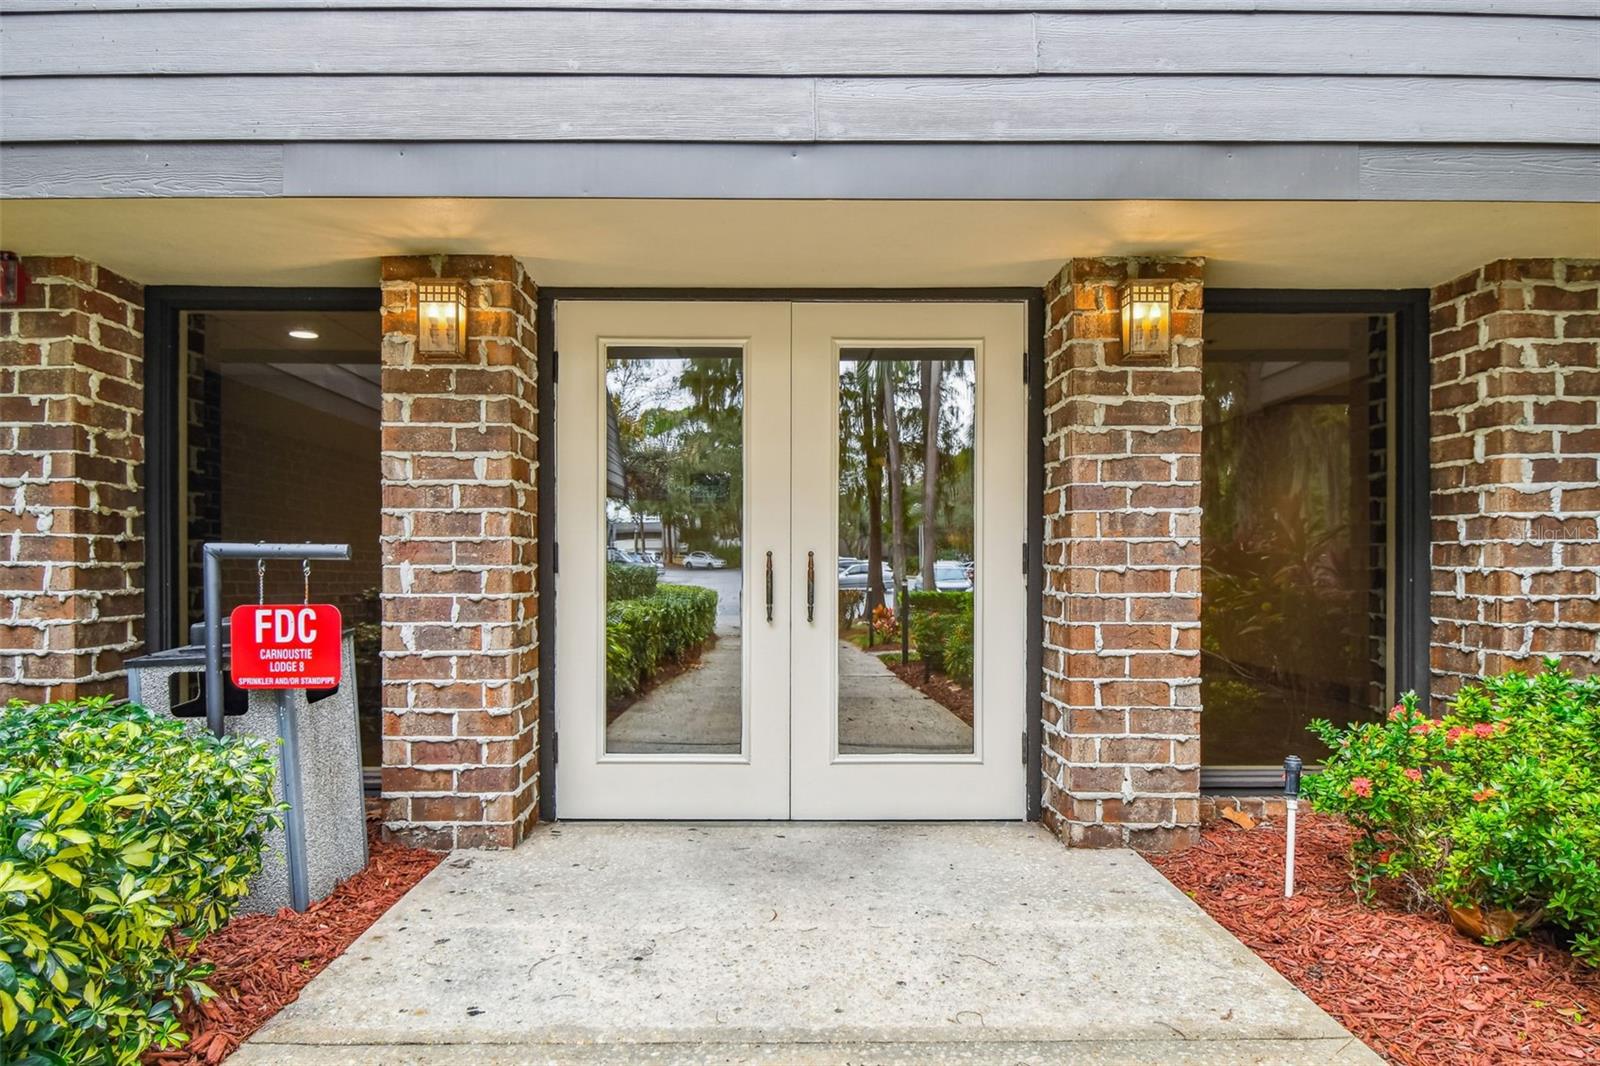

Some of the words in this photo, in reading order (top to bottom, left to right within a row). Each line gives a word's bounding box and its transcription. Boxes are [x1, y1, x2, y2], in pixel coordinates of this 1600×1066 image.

[255, 608, 317, 644] FDC
[259, 649, 313, 660] CARNOUSTIE
[270, 661, 297, 672] LODGE
[299, 661, 304, 672] 8
[238, 677, 273, 685] SPRINKLER
[275, 677, 299, 685] AND/OR
[301, 677, 335, 685] STANDPIPE
